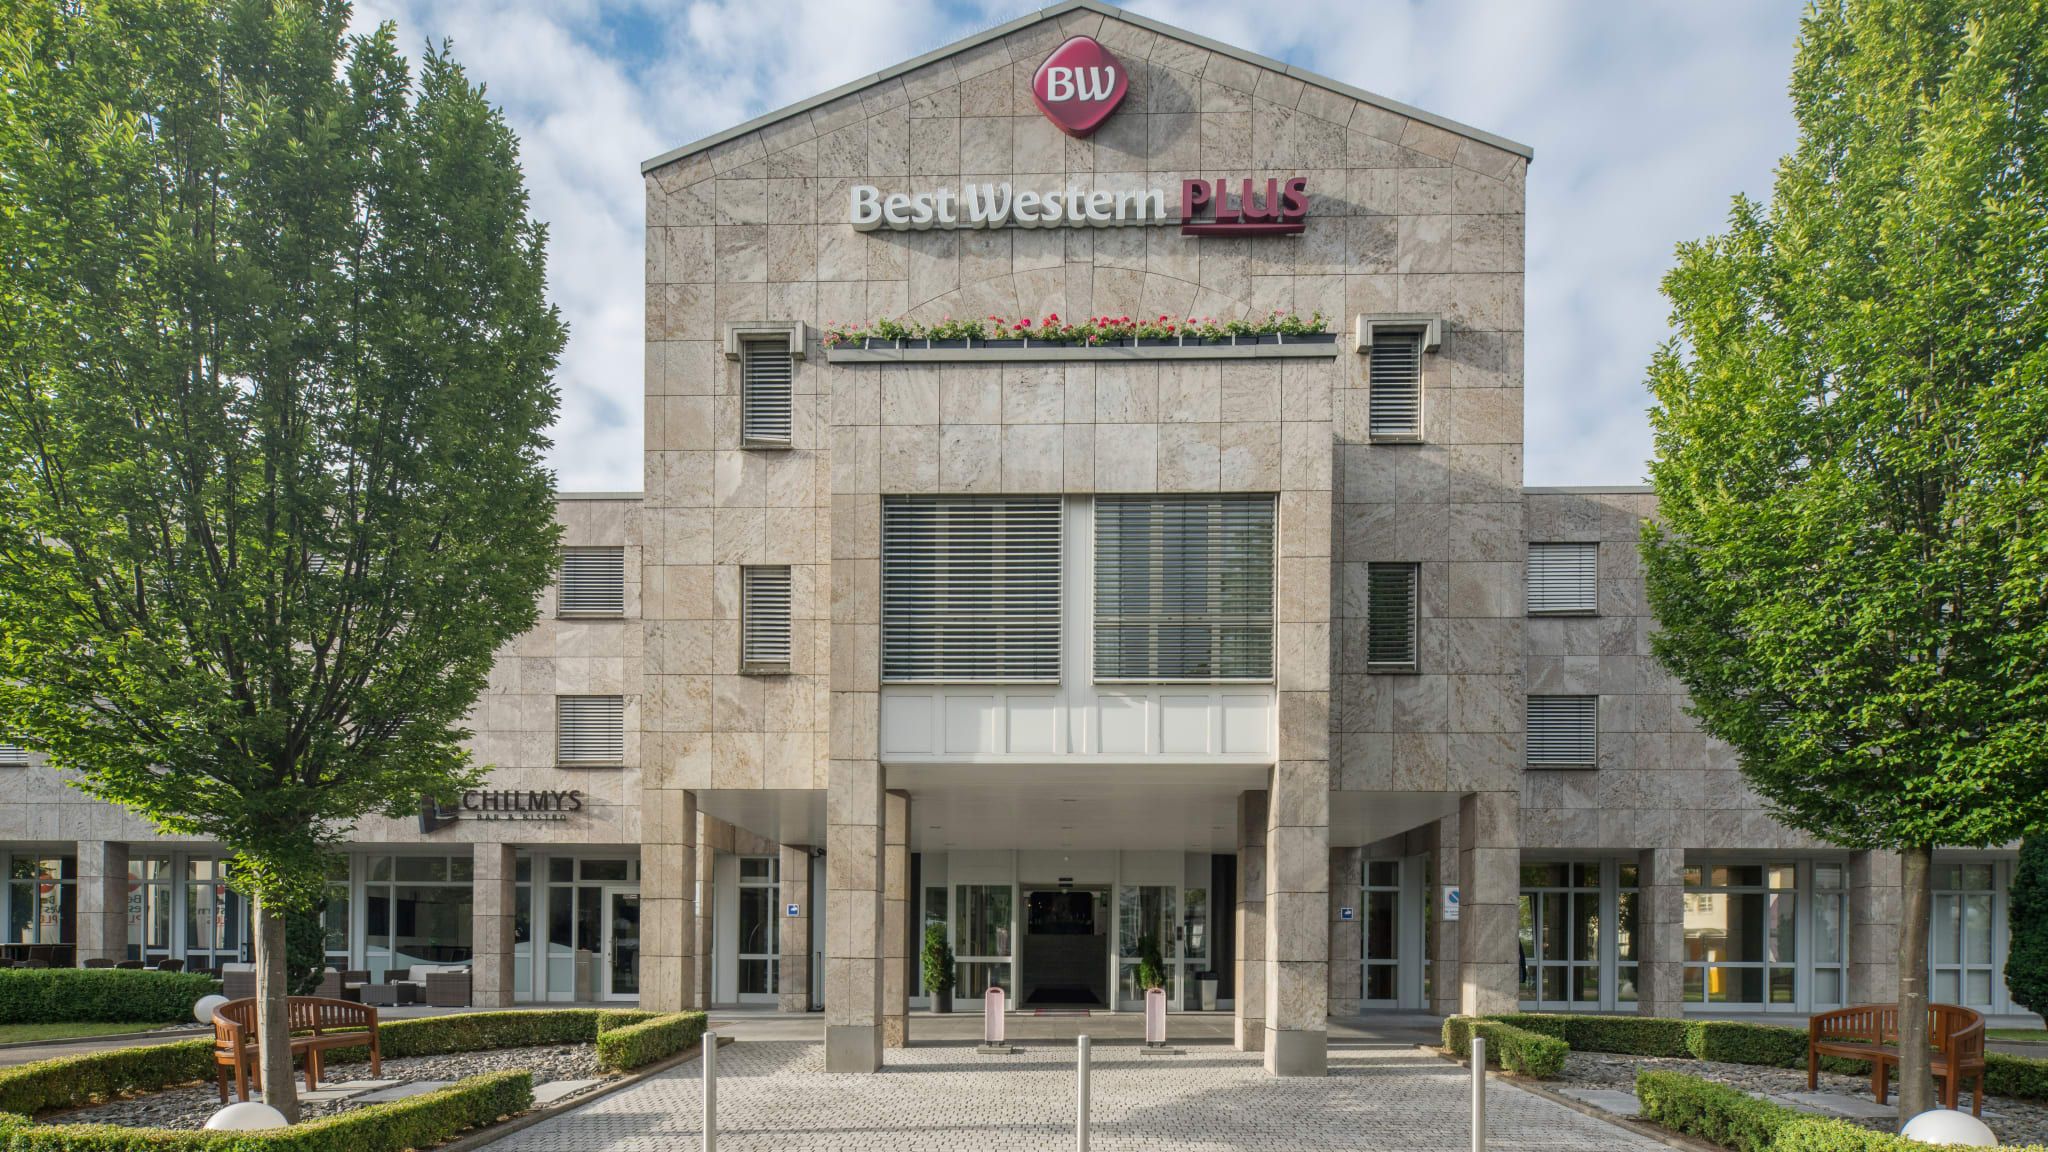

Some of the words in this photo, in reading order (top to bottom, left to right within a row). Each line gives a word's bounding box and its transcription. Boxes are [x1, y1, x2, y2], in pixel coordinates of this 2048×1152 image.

[1047, 66, 1116, 102] BW
[850, 184, 957, 231] Best
[966, 183, 1167, 229] Western
[1181, 177, 1309, 225] PLUS
[463, 790, 582, 811] CHILMYS
[476, 813, 500, 821] BAR
[508, 813, 515, 821] &
[522, 813, 568, 821] BISTRO
